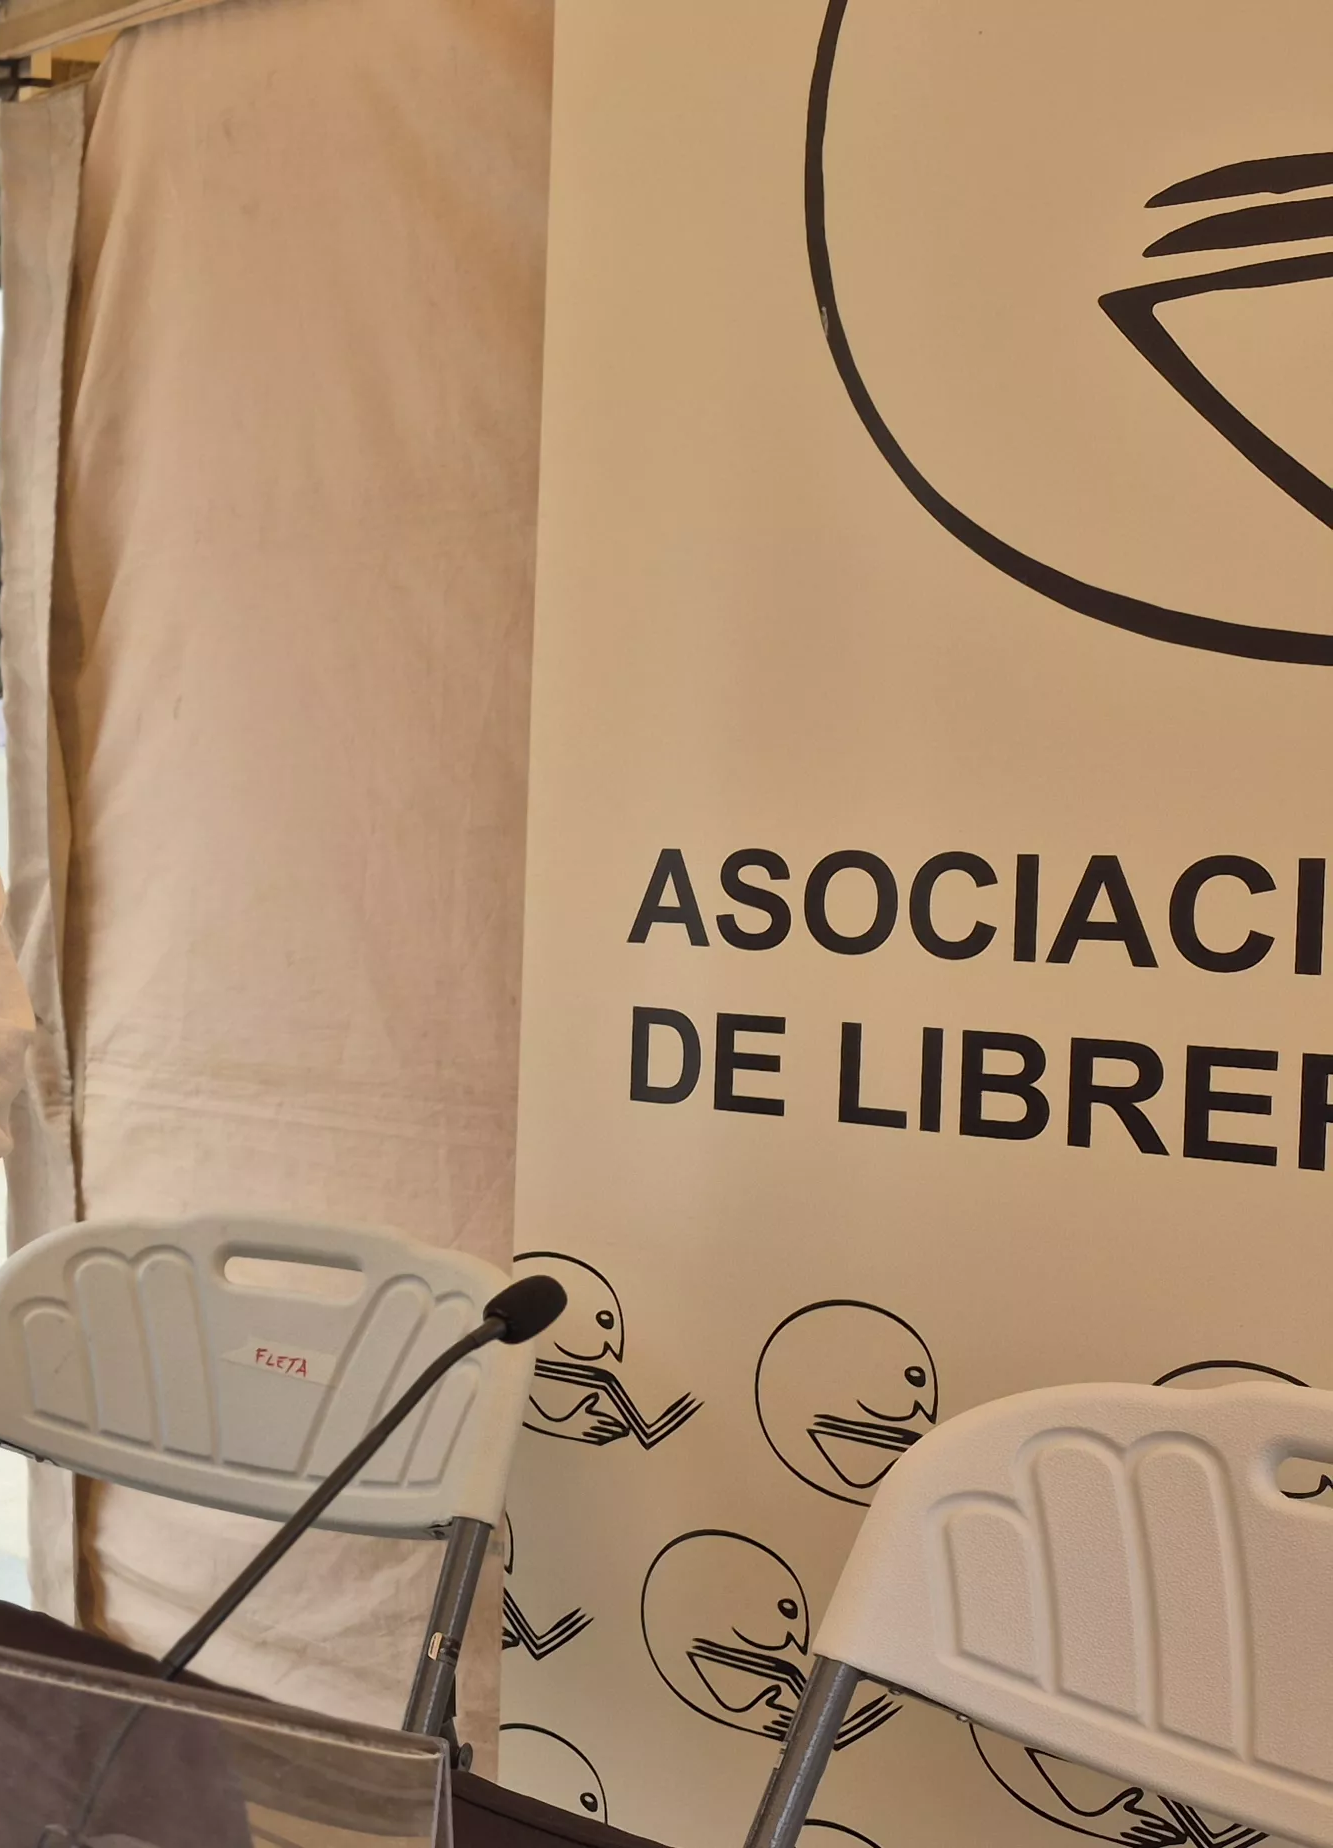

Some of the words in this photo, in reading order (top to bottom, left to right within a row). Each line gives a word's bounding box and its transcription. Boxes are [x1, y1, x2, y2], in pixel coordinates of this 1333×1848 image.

[627, 848, 1325, 975] ASOCIACI
[629, 1006, 786, 1116] DE
[255, 1347, 307, 1378] FLETA
